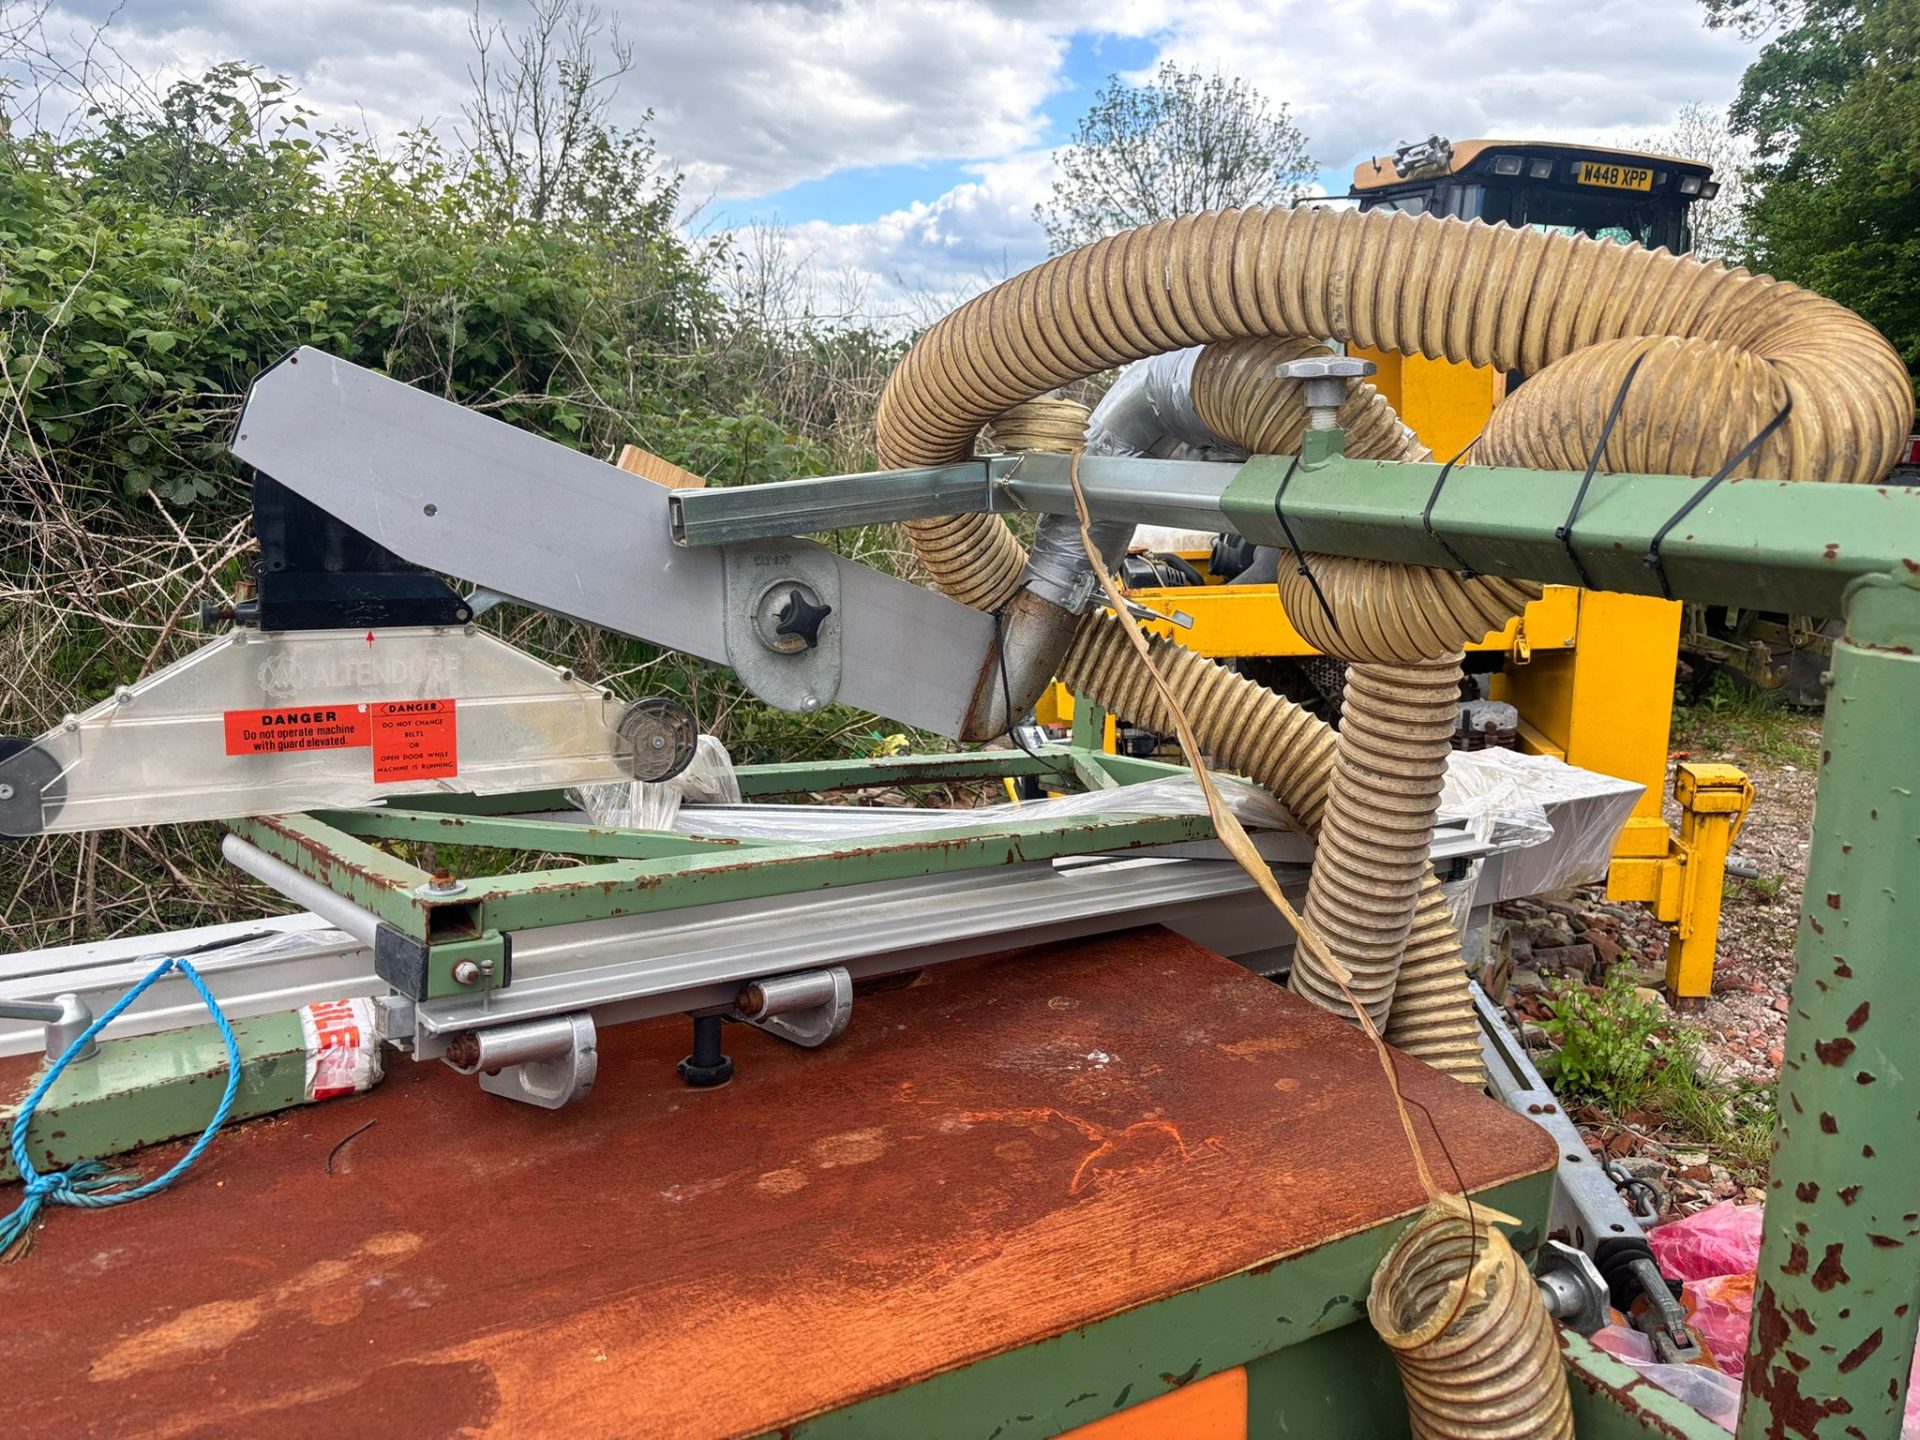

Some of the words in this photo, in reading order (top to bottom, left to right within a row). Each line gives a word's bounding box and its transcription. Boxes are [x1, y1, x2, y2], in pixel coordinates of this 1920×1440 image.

[1583, 164, 1620, 185] W448
[1620, 168, 1648, 188] XPP
[313, 655, 458, 688] ALTENDORF
[389, 702, 437, 713] DANGER
[261, 711, 337, 726] DANGER
[415, 718, 443, 726] CHANGE
[243, 729, 257, 741] Do
[259, 730, 275, 740] not
[277, 727, 314, 741] operate
[316, 724, 355, 736] machine
[253, 740, 275, 751] with
[277, 738, 305, 752] guard
[306, 735, 348, 748] elevated.
[377, 765, 408, 773] MACHINE
[421, 761, 454, 770] RUNNING
